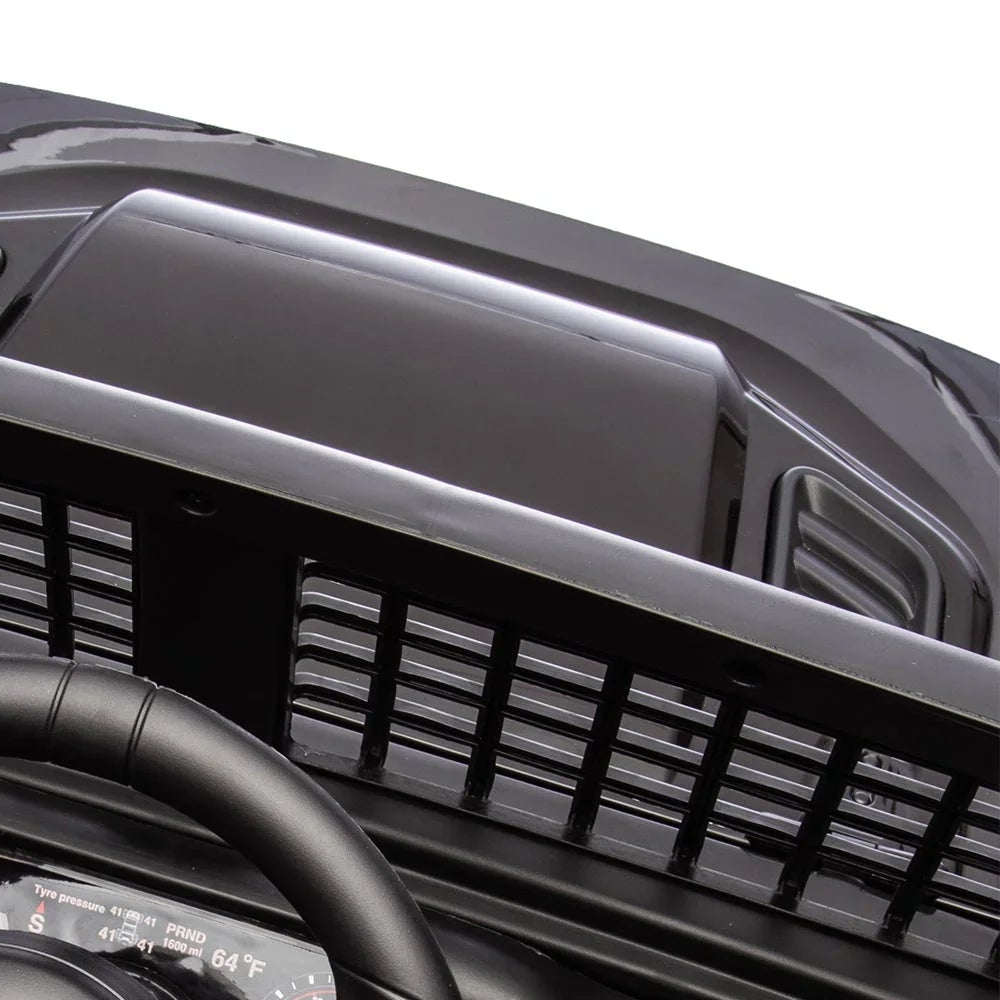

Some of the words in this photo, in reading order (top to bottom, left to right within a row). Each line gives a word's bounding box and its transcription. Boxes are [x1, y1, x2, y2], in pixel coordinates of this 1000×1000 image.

[34, 884, 57, 898] Tyre
[58, 893, 106, 914] pressure
[110, 905, 122, 917] 41
[28, 913, 45, 934] S
[144, 916, 157, 927] 41
[98, 926, 116, 942] 41
[165, 922, 207, 944] PRND
[136, 939, 154, 954] 41
[163, 937, 188, 954] 1600
